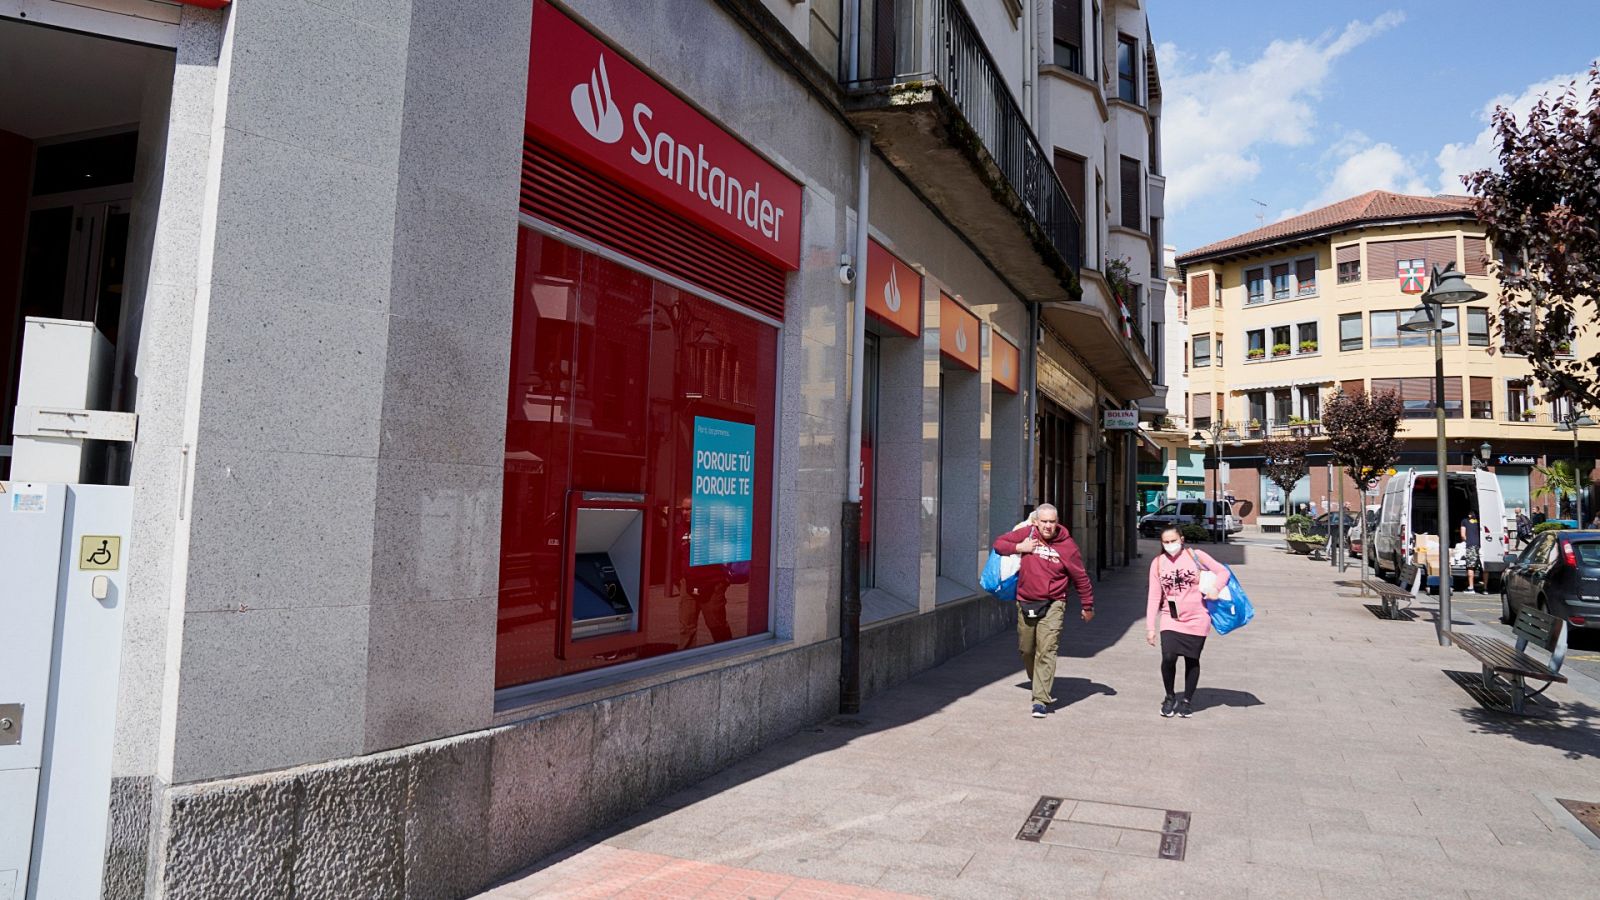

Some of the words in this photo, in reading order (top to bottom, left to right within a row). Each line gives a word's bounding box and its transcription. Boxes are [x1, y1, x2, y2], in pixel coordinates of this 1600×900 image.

[630, 102, 784, 243] Santander
[696, 450, 737, 472] PORQUE
[738, 451, 751, 472] TÚ
[696, 476, 736, 497] PORQUE
[738, 477, 750, 495] TE
